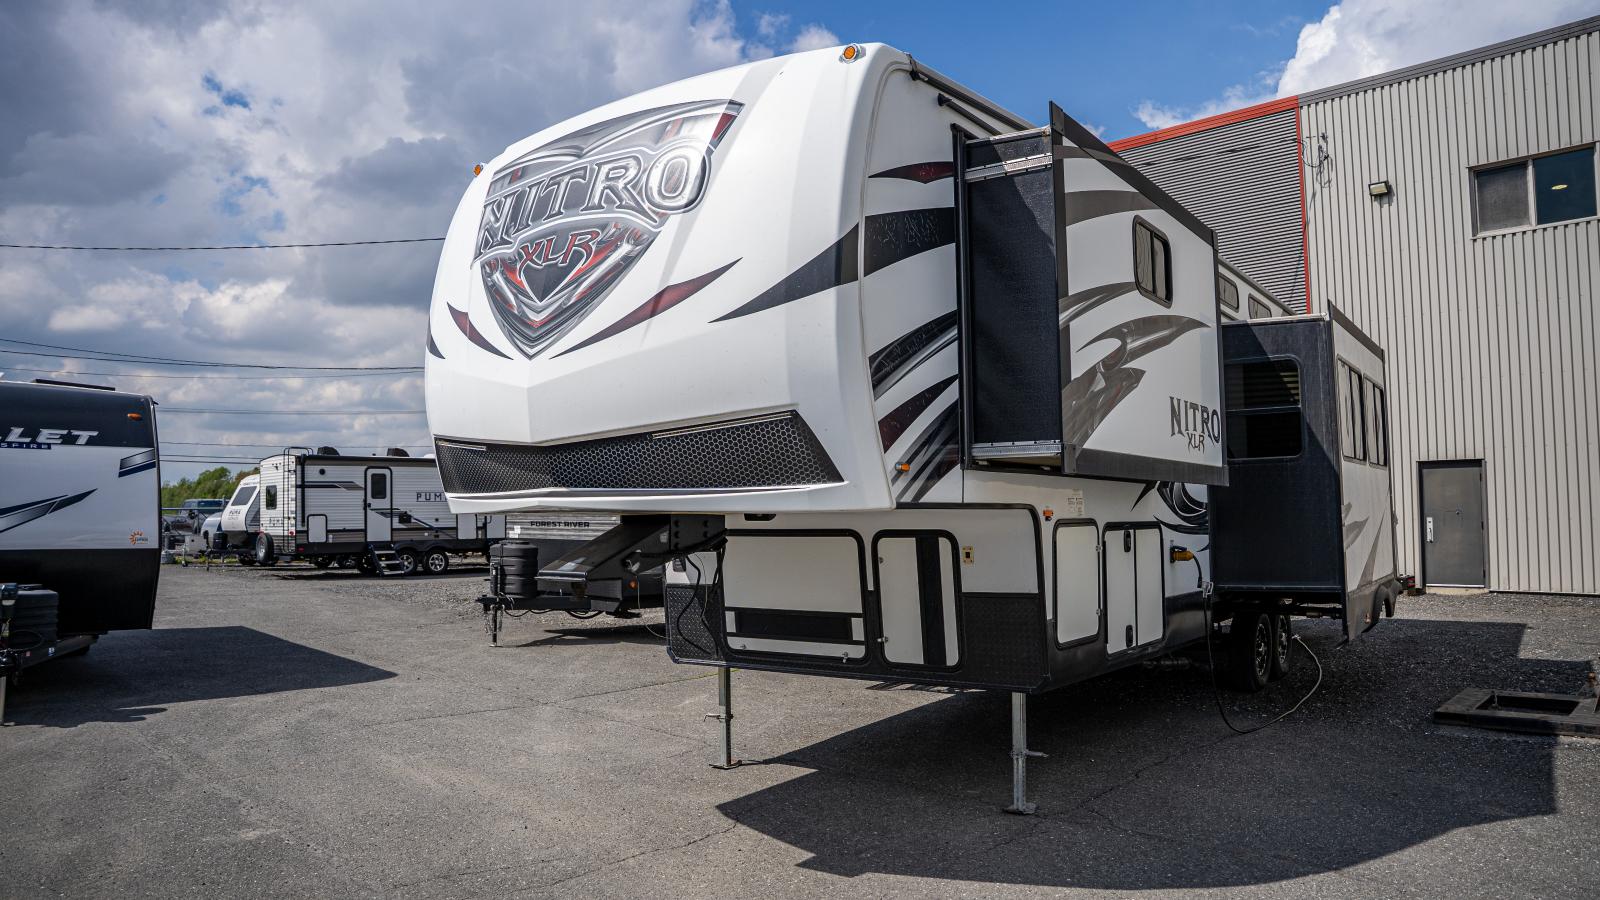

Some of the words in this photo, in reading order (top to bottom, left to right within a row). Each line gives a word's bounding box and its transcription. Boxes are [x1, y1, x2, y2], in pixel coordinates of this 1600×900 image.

[479, 145, 711, 252] NITRO
[518, 229, 601, 280] XLR
[0, 427, 99, 444] LET
[1169, 395, 1221, 447] NITRO
[1187, 432, 1205, 454] XLR
